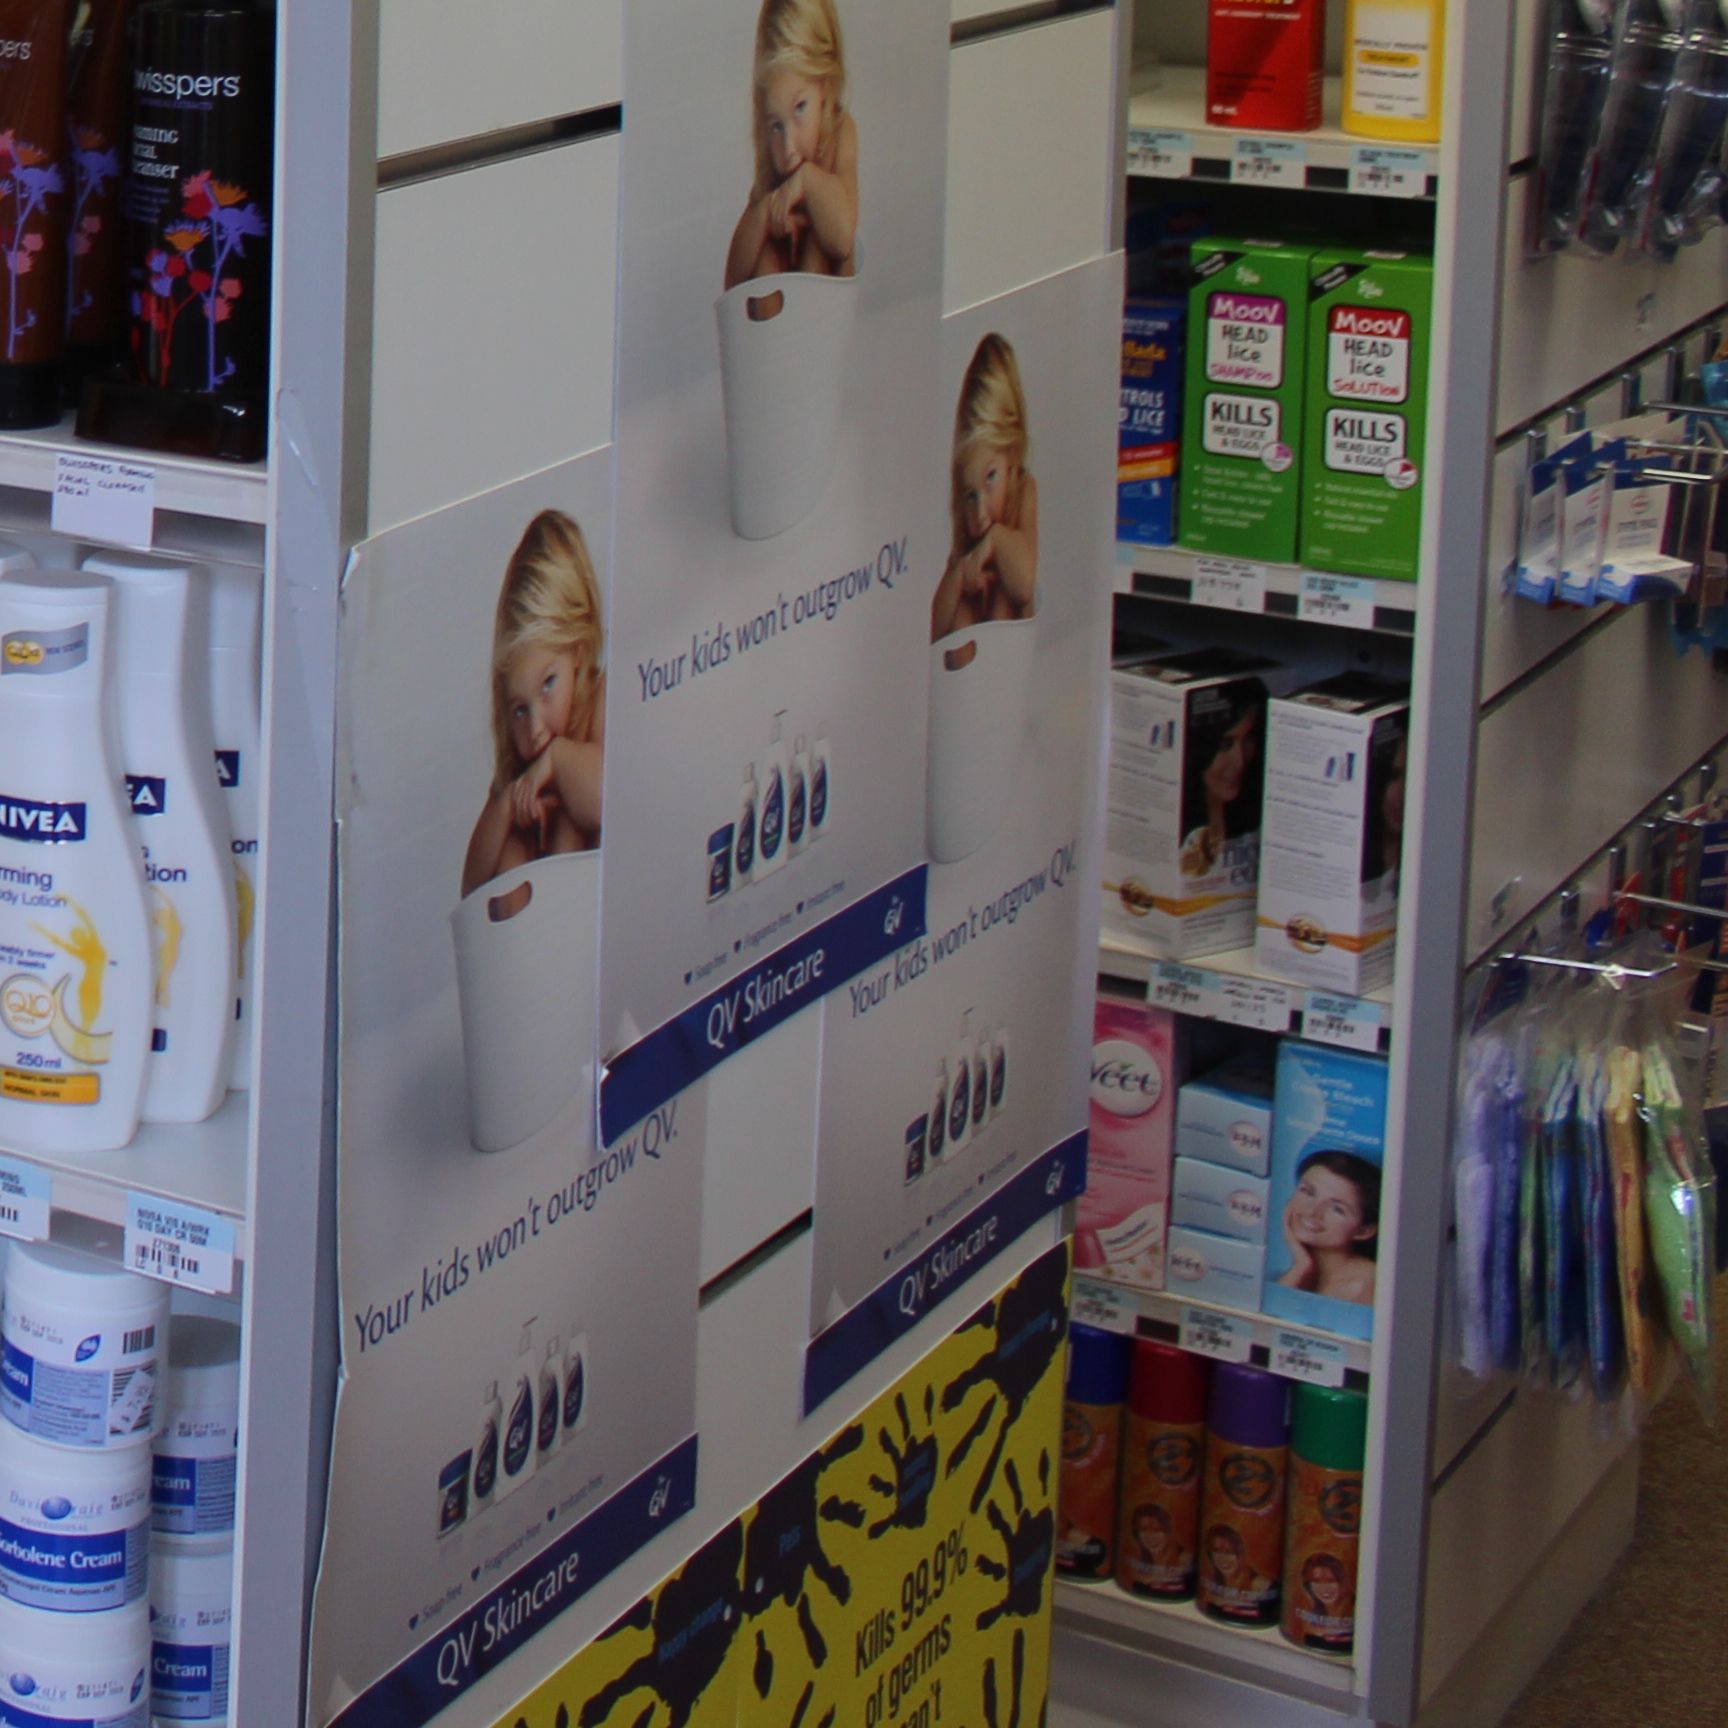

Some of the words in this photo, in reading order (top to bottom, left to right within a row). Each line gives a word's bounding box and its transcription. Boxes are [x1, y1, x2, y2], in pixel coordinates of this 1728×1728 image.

[1222, 324, 1270, 345] HEAD
[1227, 342, 1263, 364] lice
[1343, 338, 1394, 359] HEAD
[1350, 358, 1387, 379] lice
[1210, 399, 1274, 428] KILLS
[1332, 416, 1399, 444] KILLS
[637, 651, 685, 703] Your
[689, 619, 732, 679] kids
[735, 589, 790, 653] won't
[792, 560, 874, 626] outgrow
[22, 886, 68, 909] Lotion
[847, 969, 888, 1020] Your
[893, 931, 929, 990] kids
[932, 903, 978, 965] won't
[980, 870, 1047, 932] outgrow
[706, 1000, 742, 1050] QV
[743, 946, 825, 1027] Skincare
[354, 1291, 415, 1355] Your
[420, 1246, 471, 1314] kids
[475, 1196, 542, 1275] won't
[546, 1134, 639, 1226] outgrow
[928, 1214, 999, 1289] Skincare
[69, 1546, 124, 1570] Cream
[900, 1519, 969, 1633] 99.9%
[436, 1626, 479, 1689] QV
[481, 1549, 581, 1659] Skincare
[854, 1606, 898, 1679] Kills
[887, 1612, 953, 1721] germs
